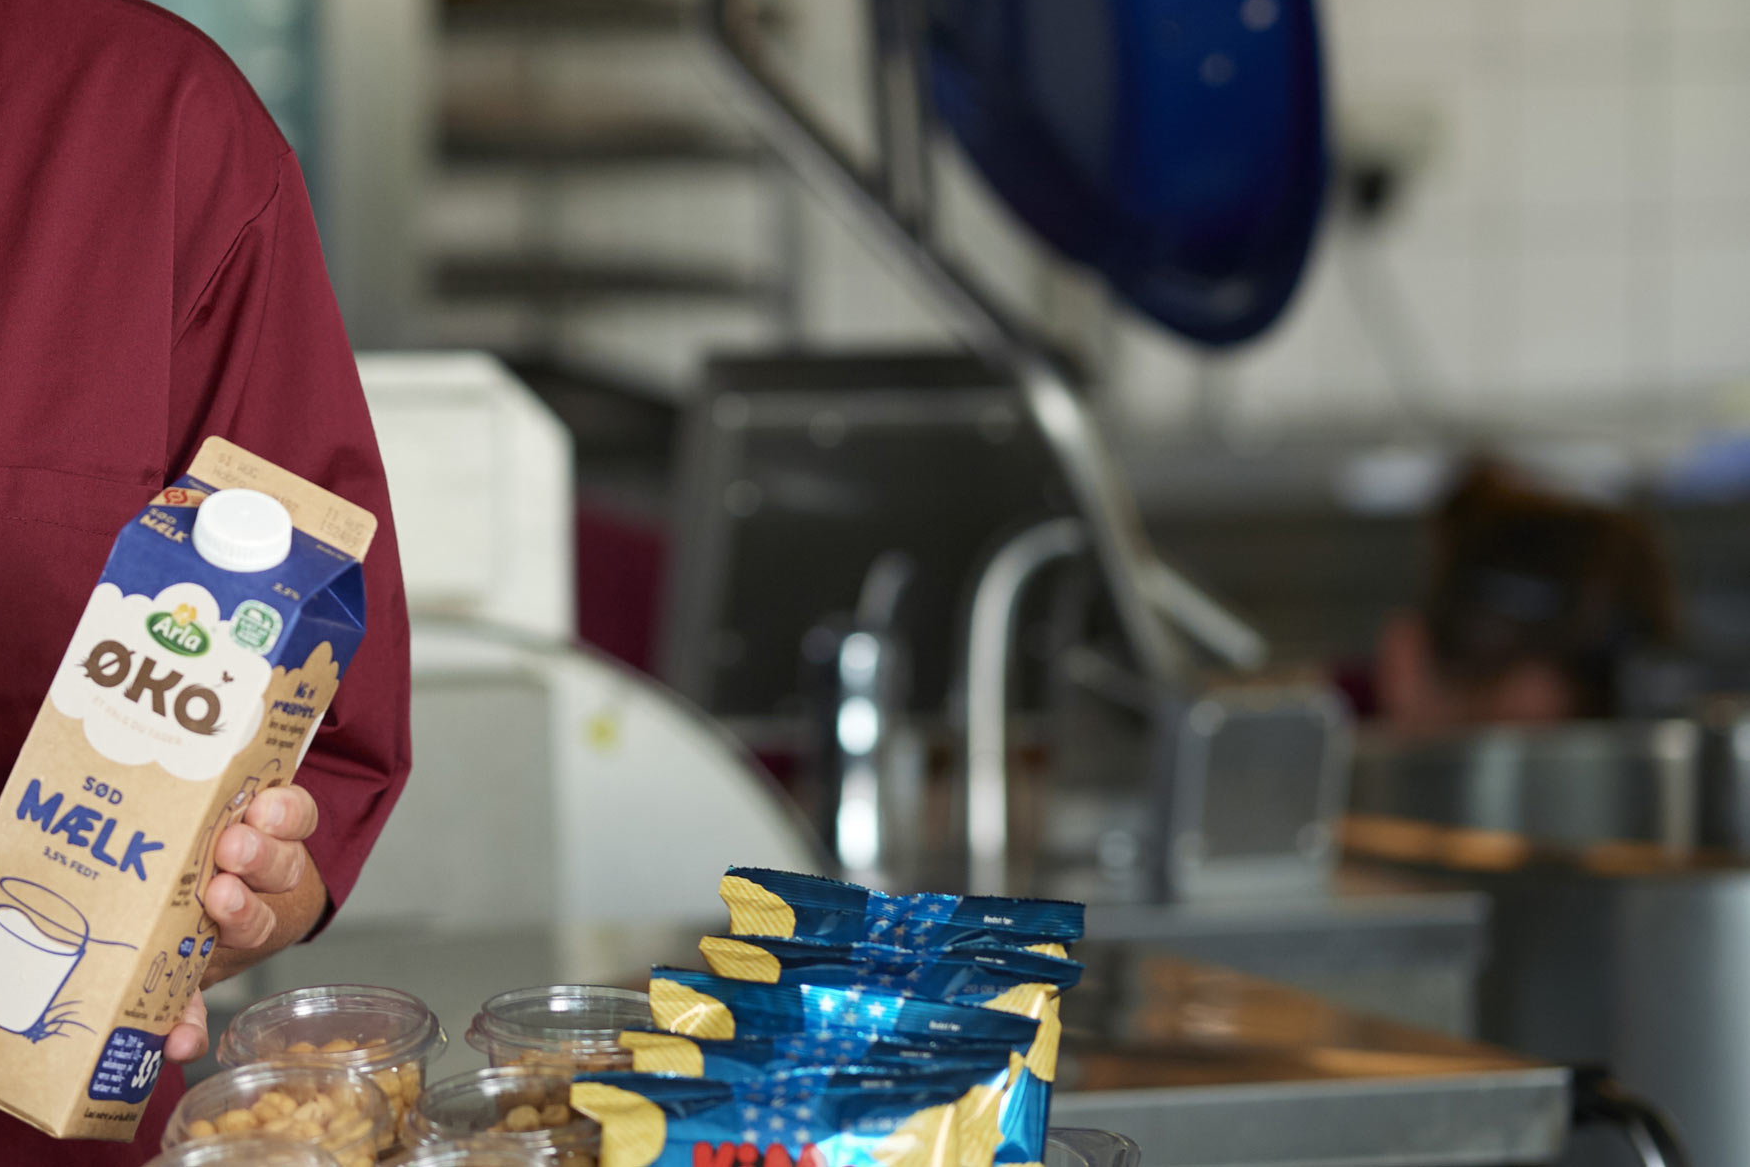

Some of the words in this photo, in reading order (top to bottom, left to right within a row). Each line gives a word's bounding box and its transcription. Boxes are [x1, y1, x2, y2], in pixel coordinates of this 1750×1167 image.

[139, 513, 189, 544] MÆLK
[152, 615, 203, 653] Arla
[79, 639, 226, 736] ØKO
[82, 776, 123, 805] SØD
[16, 778, 165, 881] MÆLK
[68, 859, 100, 881] FEDT
